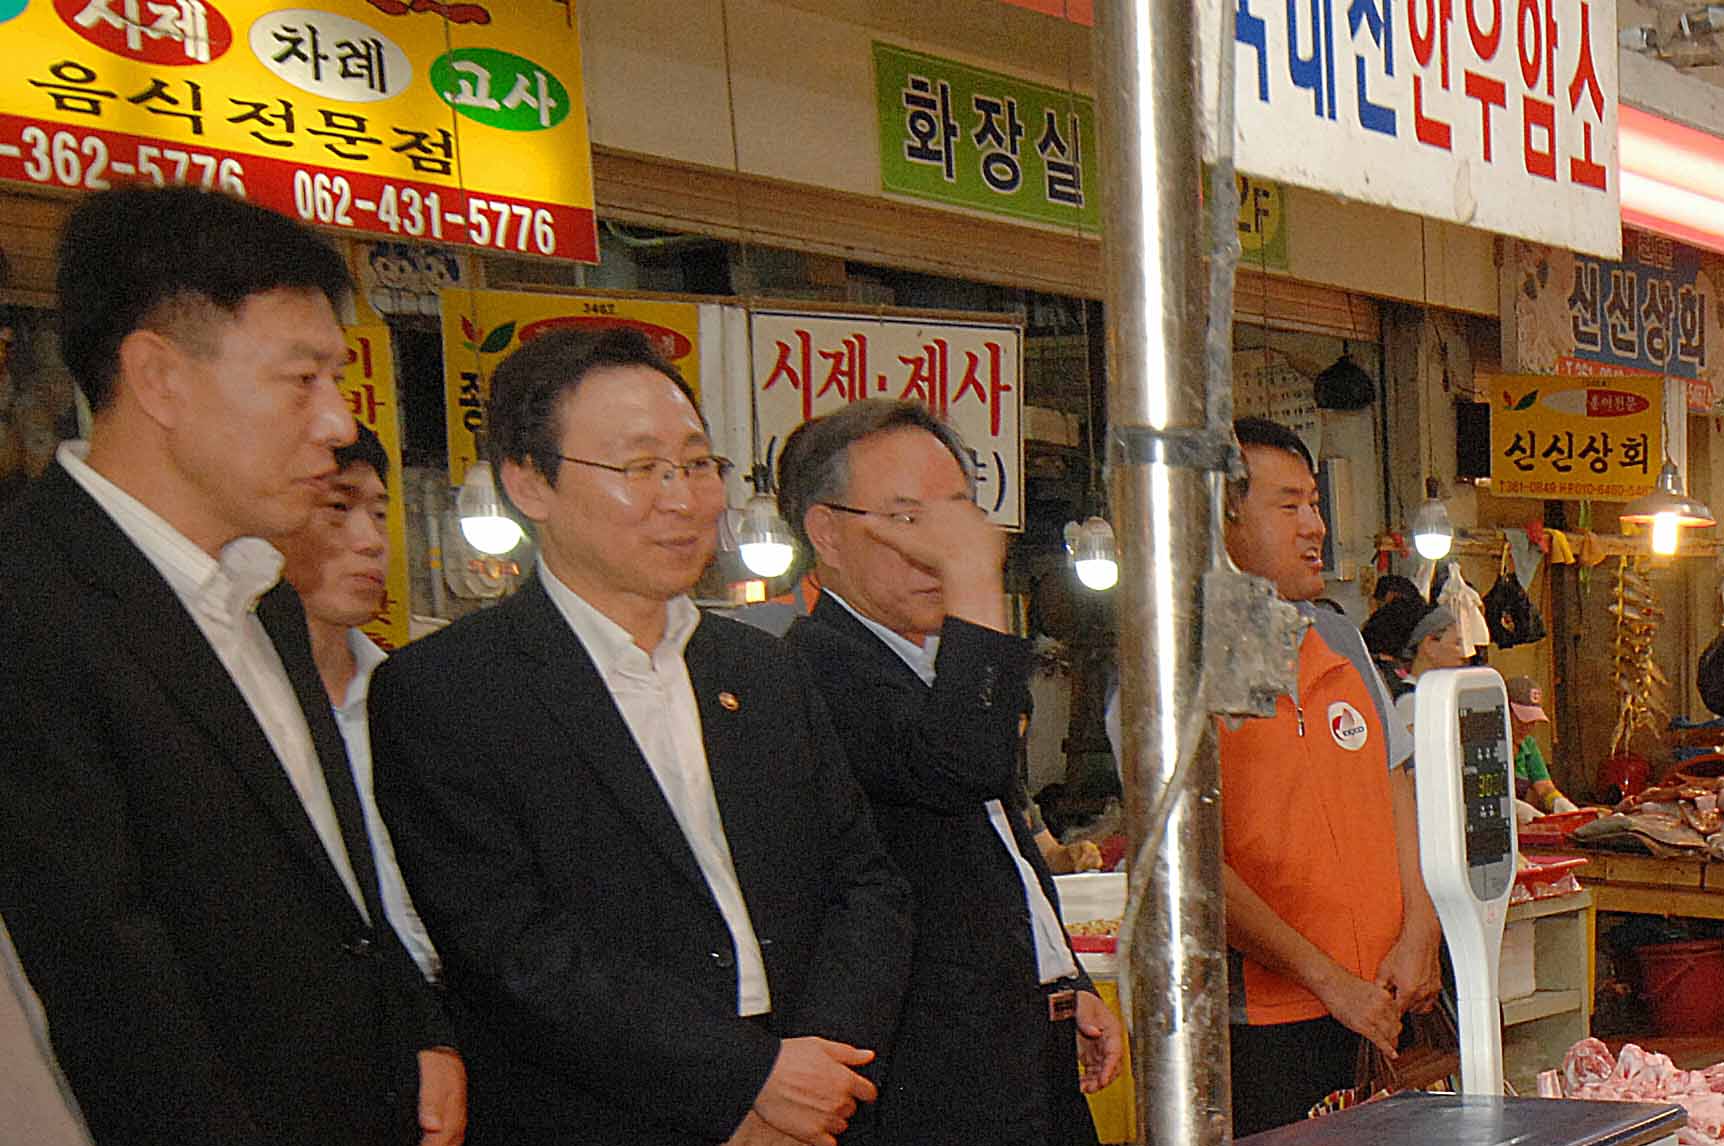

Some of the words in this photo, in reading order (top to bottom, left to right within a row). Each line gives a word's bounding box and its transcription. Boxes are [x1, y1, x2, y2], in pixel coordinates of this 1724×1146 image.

[272, 24, 387, 93] 차례
[445, 61, 556, 127] 고사
[28, 61, 203, 135] 음식
[227, 98, 454, 176] 전문점
[904, 75, 1085, 207] 화장실
[294, 170, 556, 255] 062-431-5776
[1568, 259, 1706, 368] 신신상회
[762, 329, 1012, 437] 시제·제사
[1504, 430, 1648, 474] 신신상회
